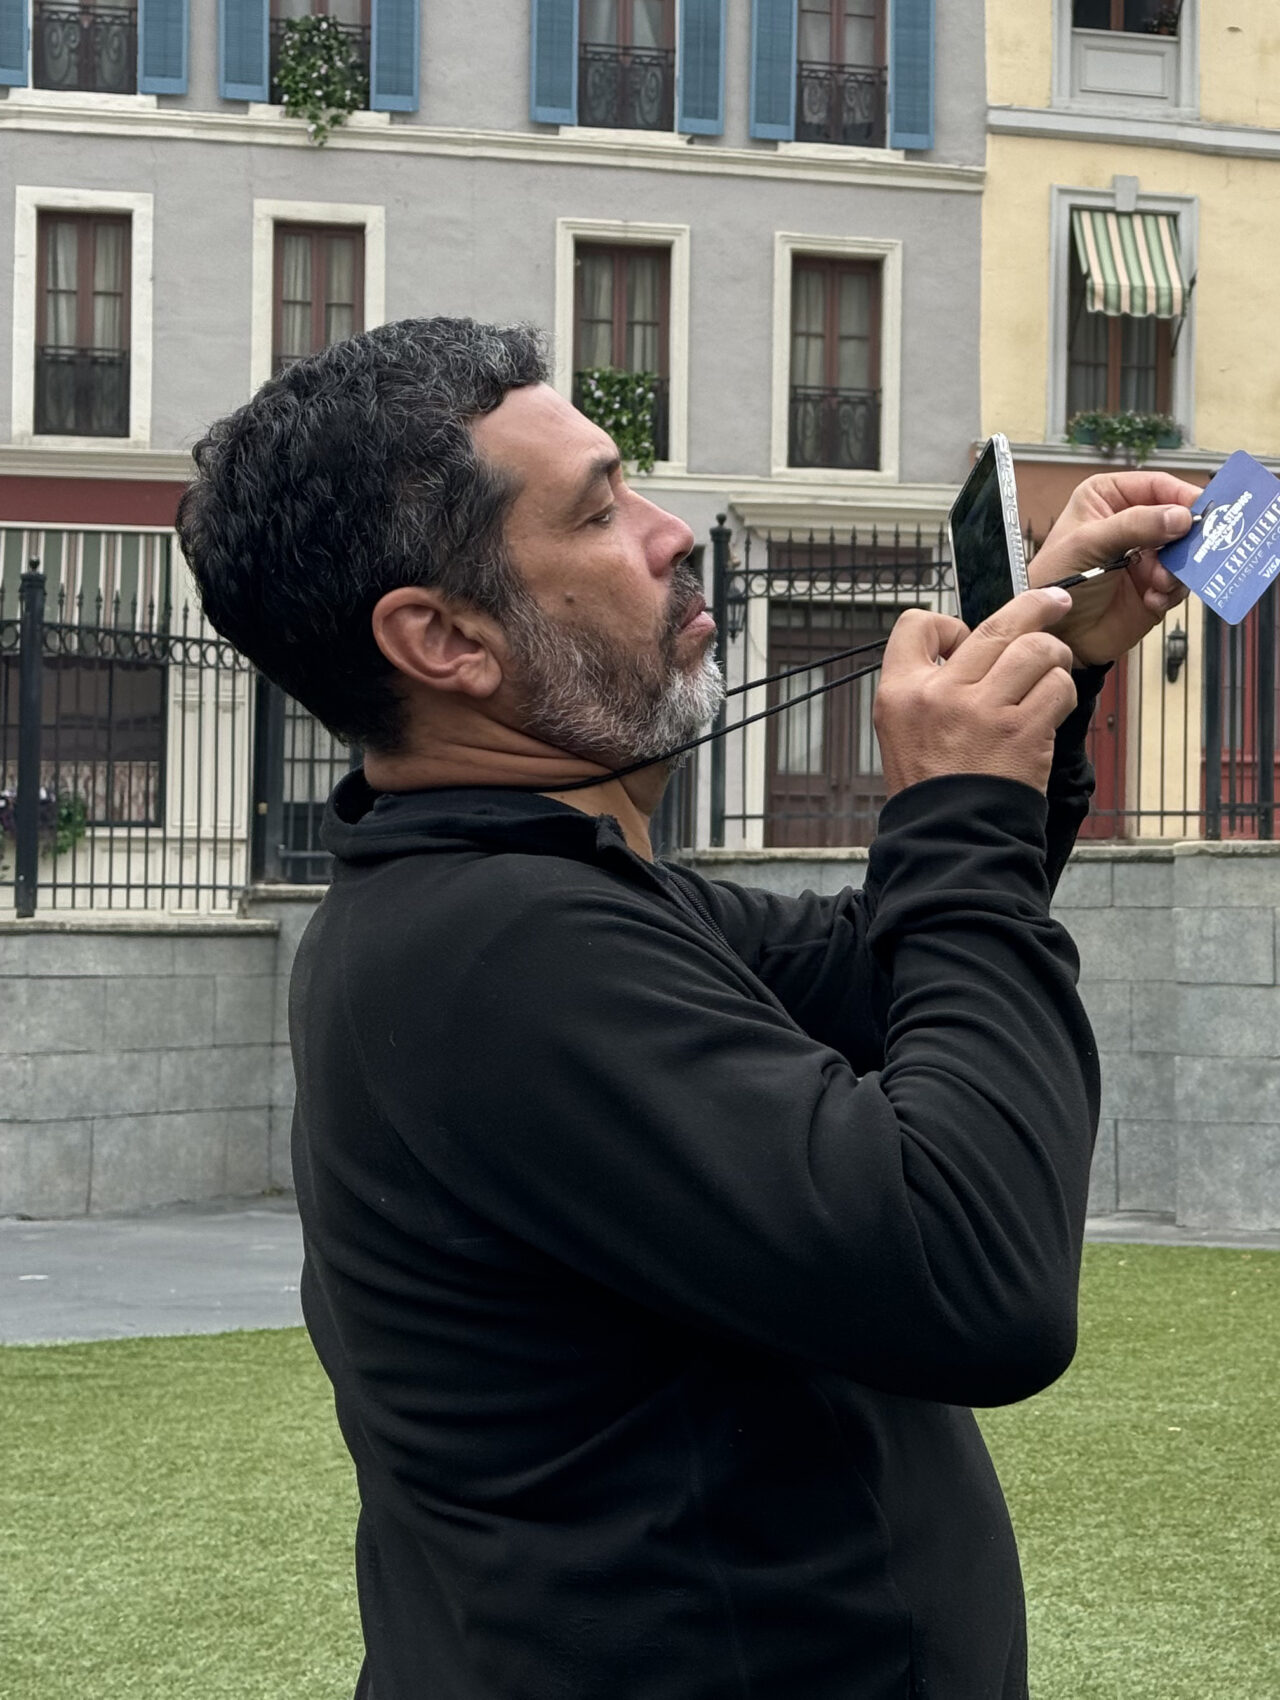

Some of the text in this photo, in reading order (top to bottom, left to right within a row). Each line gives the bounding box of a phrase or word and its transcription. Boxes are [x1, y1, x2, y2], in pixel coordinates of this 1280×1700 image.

[1193, 490, 1253, 563] UNIVERSAL STUDIOS
[1203, 573, 1225, 599] VIP
[1217, 549, 1264, 609] EXCLUSIVE
